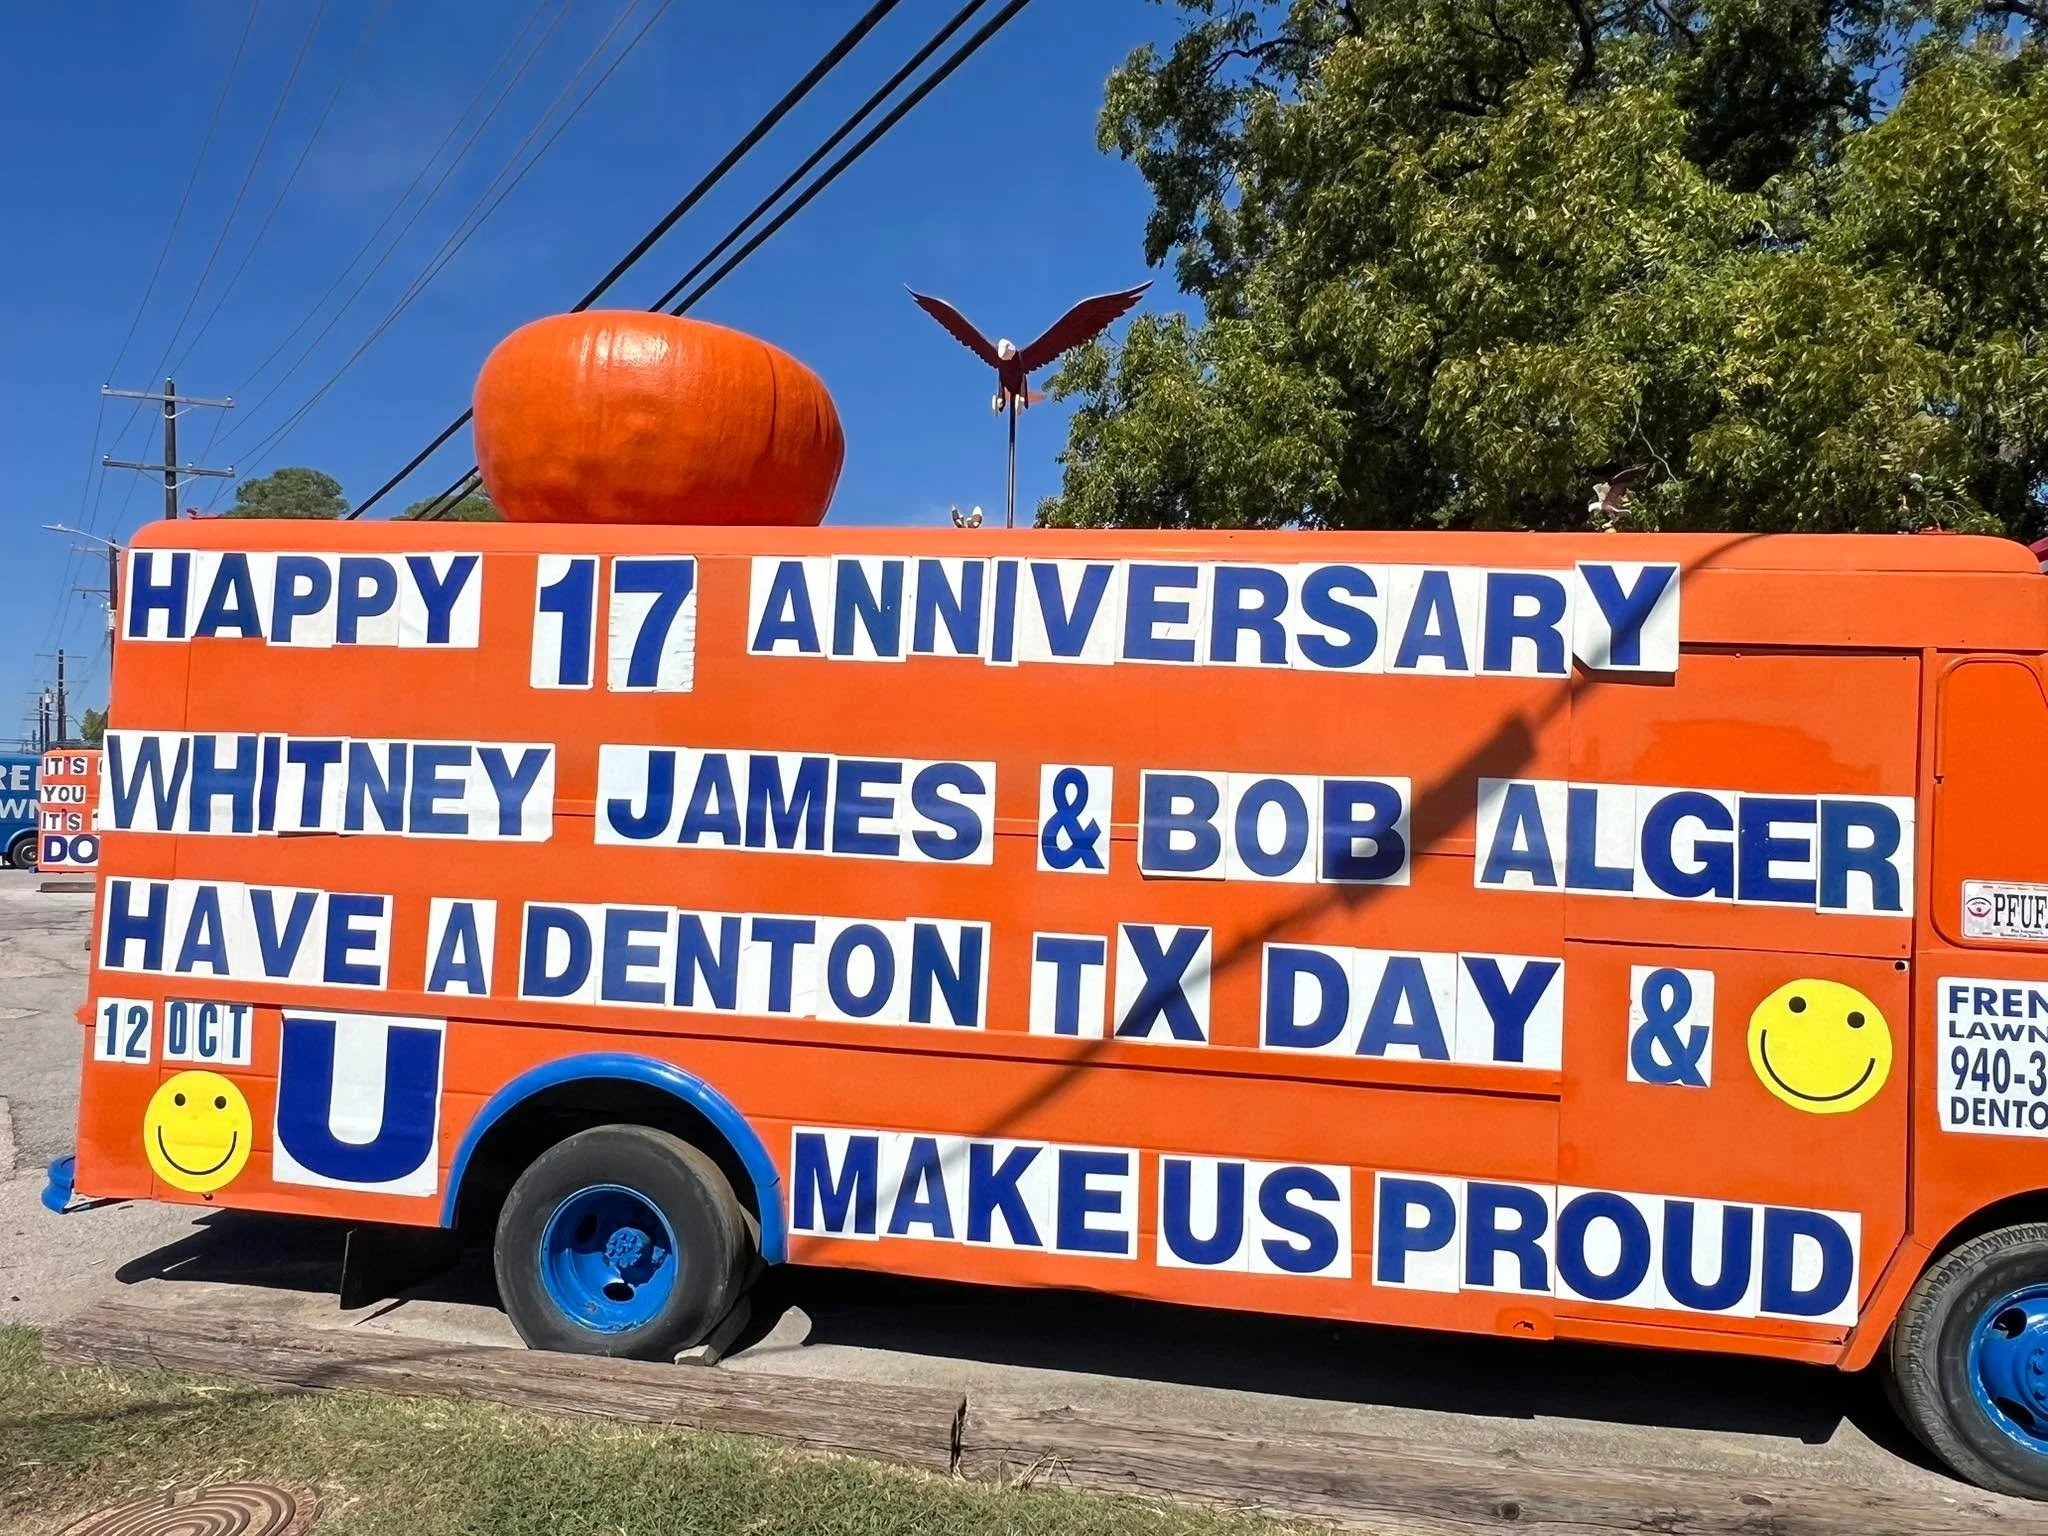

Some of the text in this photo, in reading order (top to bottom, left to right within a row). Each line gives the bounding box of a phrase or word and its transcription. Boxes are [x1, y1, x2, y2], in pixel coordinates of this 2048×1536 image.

[130, 552, 1673, 688] HAPPY 17 ANNIVERSARY
[45, 758, 85, 775] IT'S
[44, 786, 84, 802] YOU
[43, 809, 82, 830] IT'S
[106, 735, 1903, 912] WHITNEY JAMES & BOB ALGER
[43, 834, 99, 863] DO
[1993, 893, 2048, 929] PFUF
[104, 880, 1710, 1086] HAVE A DENTON TX DAY &
[104, 1002, 247, 1059] 12 OCT
[1949, 1020, 2048, 1043] LAWN
[278, 1018, 441, 1183] U
[1951, 1096, 2048, 1130] DENTO
[794, 1132, 1854, 1315] MAKE US PROUD
